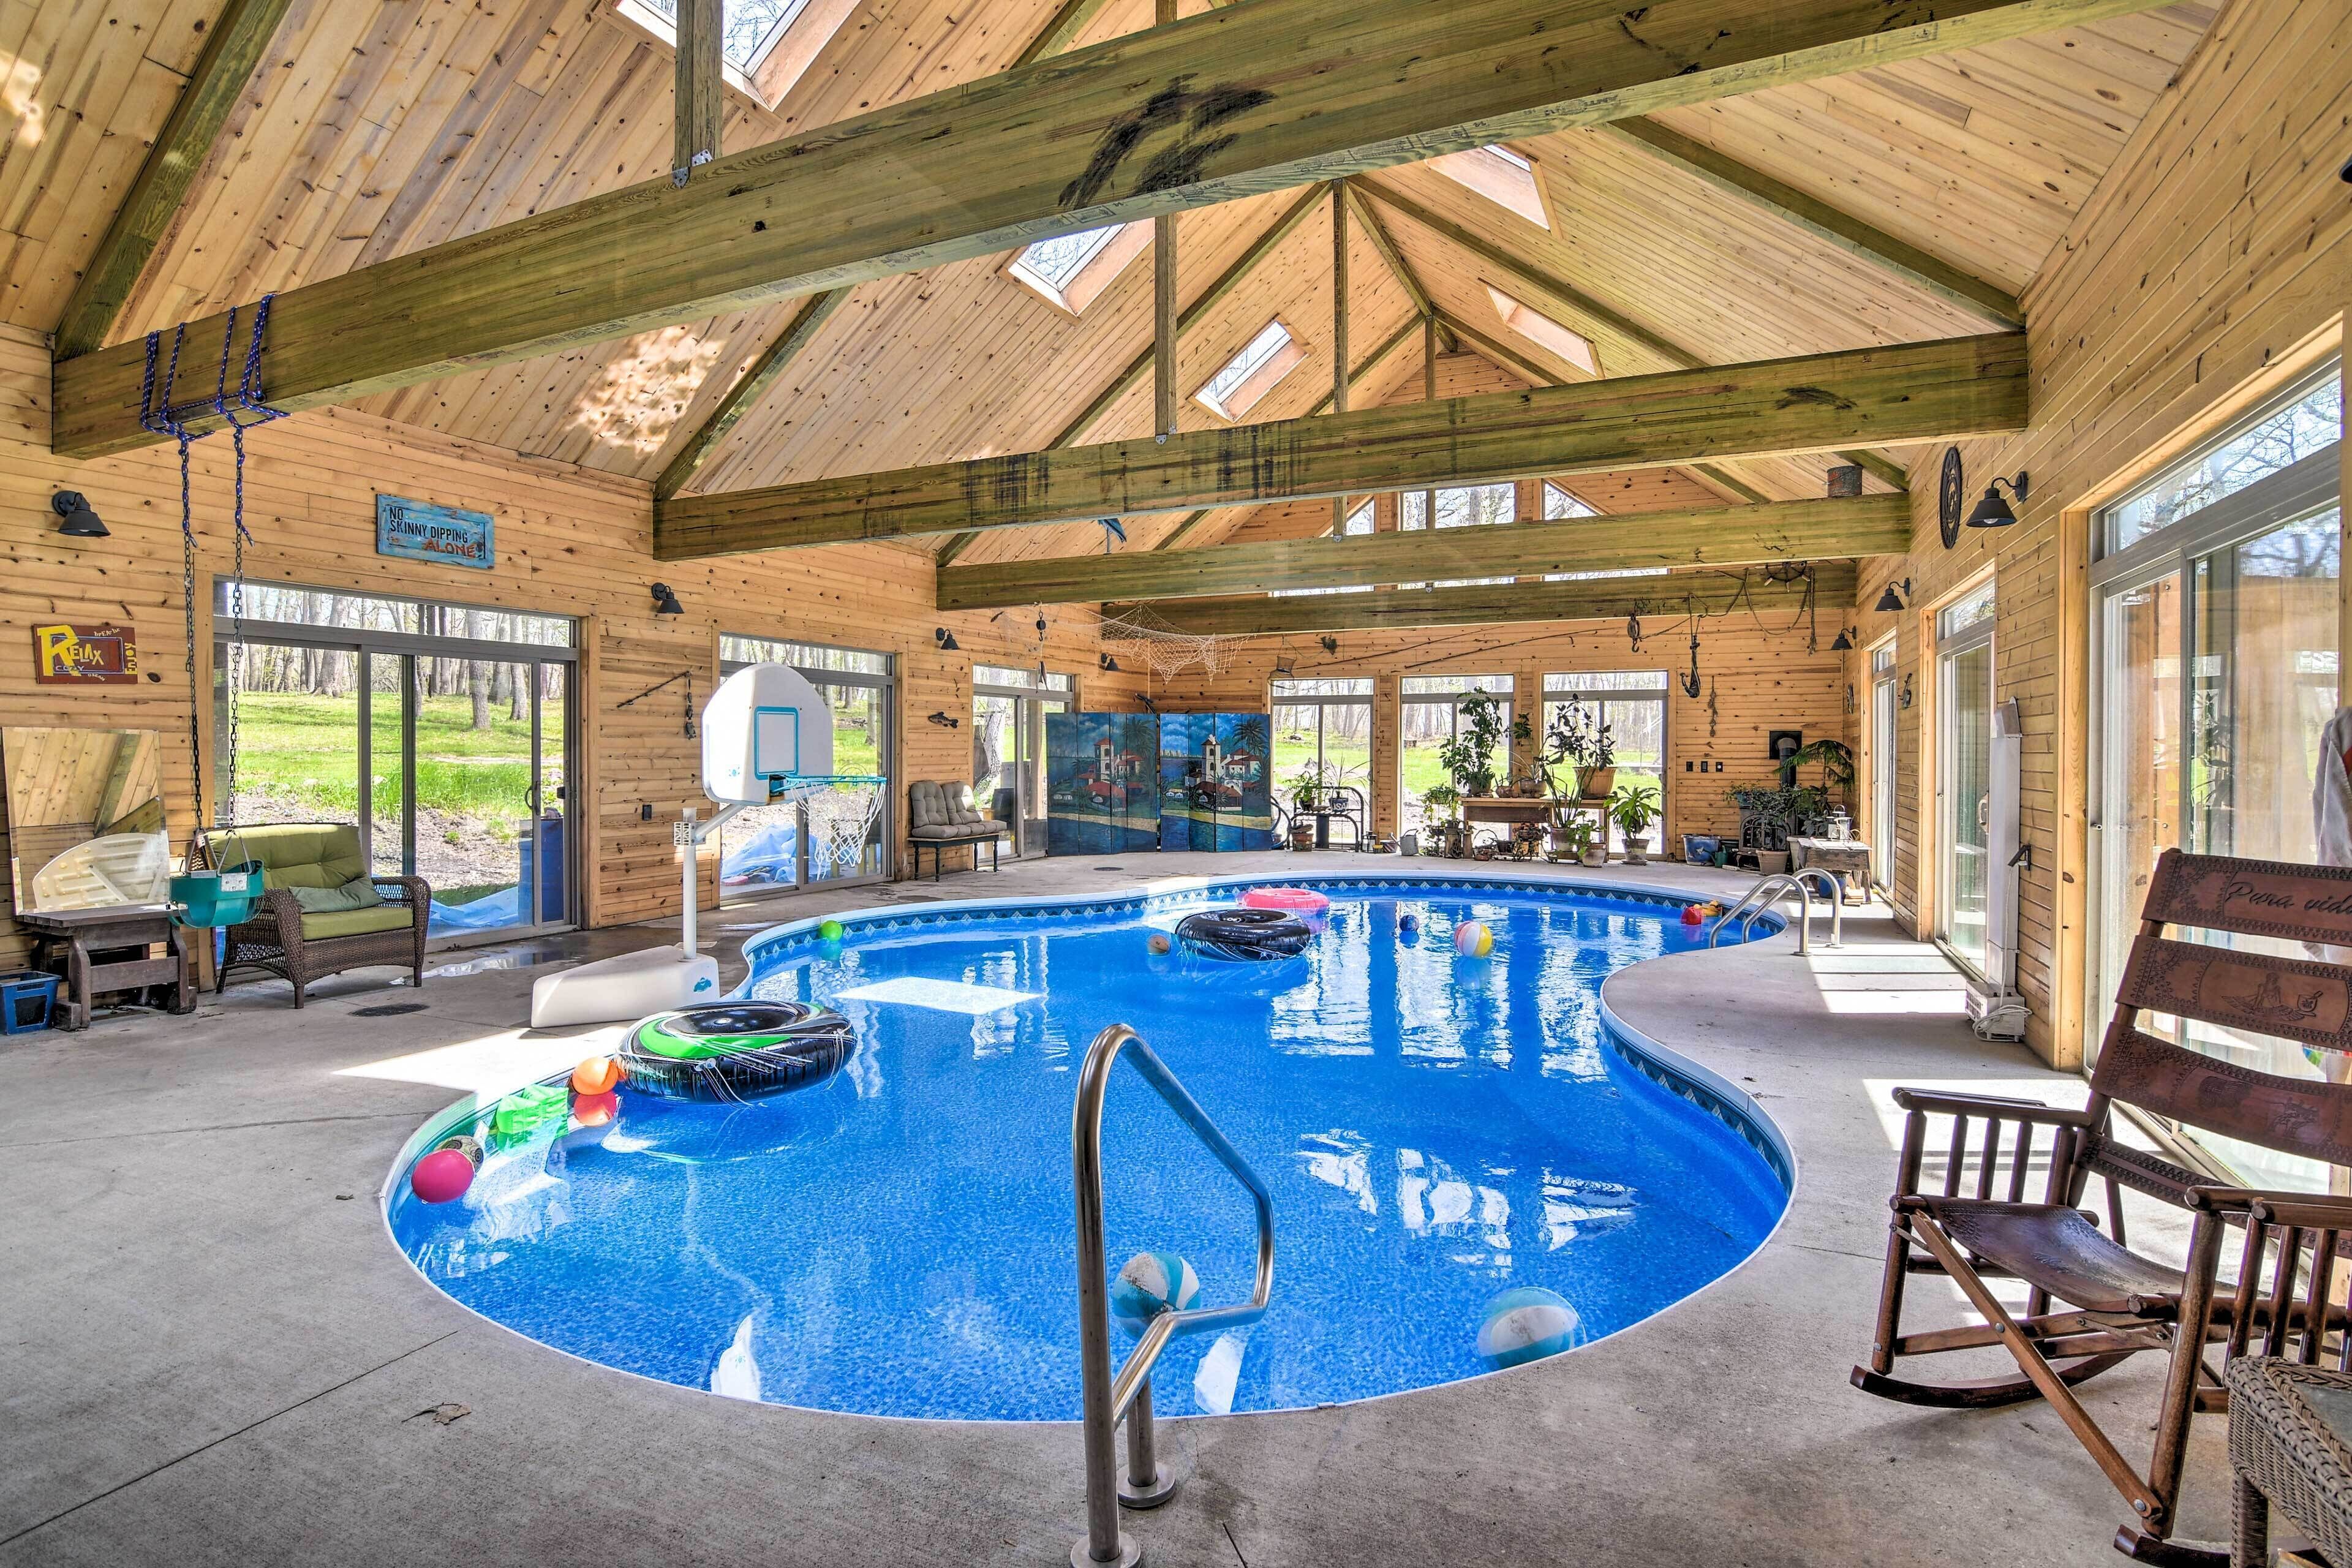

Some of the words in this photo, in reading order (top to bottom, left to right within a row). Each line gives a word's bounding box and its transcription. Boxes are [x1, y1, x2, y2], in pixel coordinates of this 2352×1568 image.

[389, 507, 404, 521] NO
[390, 519, 428, 537] SKINNY
[431, 526, 468, 543] DIPPING
[423, 538, 478, 559] ALONE
[37, 624, 105, 677] RELAX
[2225, 881, 2295, 909] Pura
